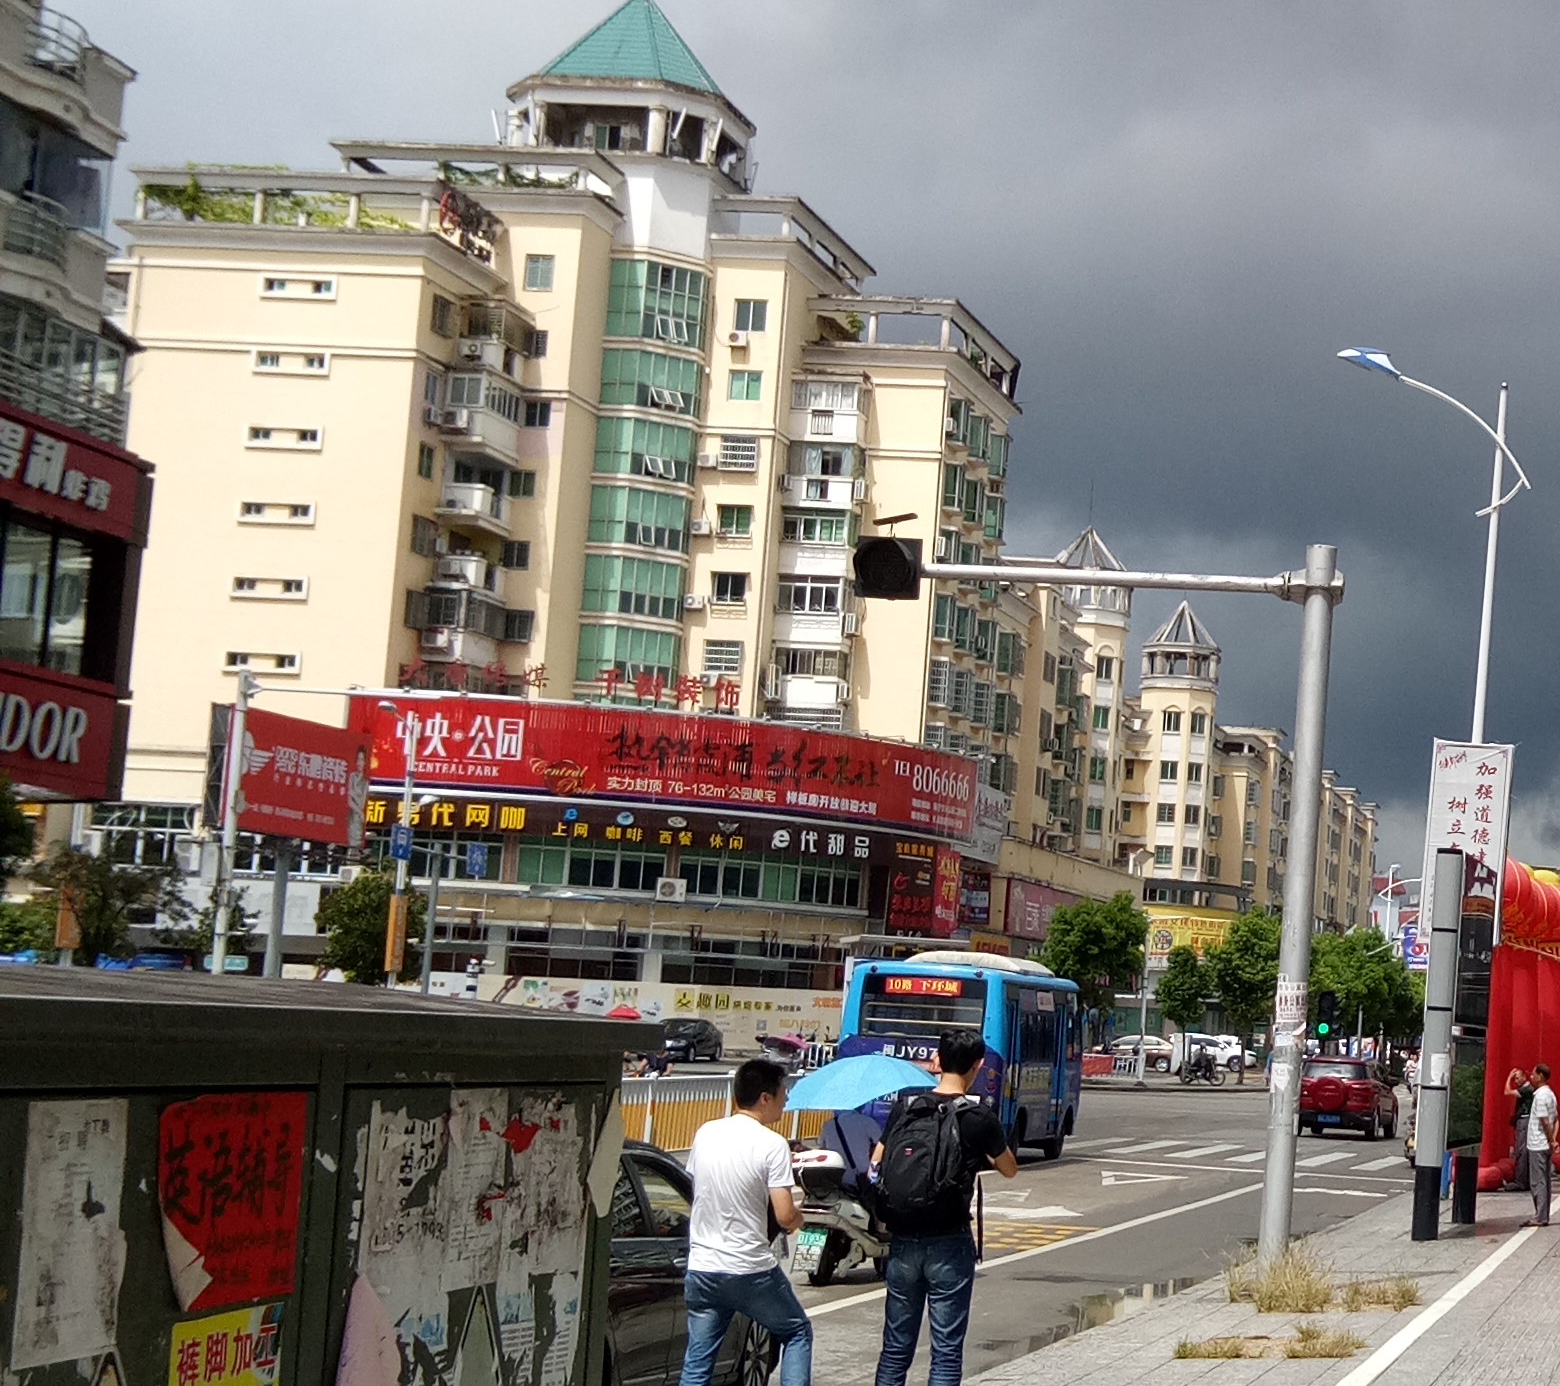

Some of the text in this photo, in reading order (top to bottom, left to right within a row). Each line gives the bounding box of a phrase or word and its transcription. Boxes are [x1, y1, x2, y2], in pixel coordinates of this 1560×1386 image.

[0, 691, 89, 765] DOR
[411, 760, 500, 778] CENTRAL PARK
[606, 775, 663, 794] 实力封顶
[893, 759, 970, 802] TEL 8066666
[551, 821, 589, 840] 上网
[605, 825, 644, 843] 咖啡
[658, 829, 693, 847] 西餐
[709, 833, 744, 852] 休闲
